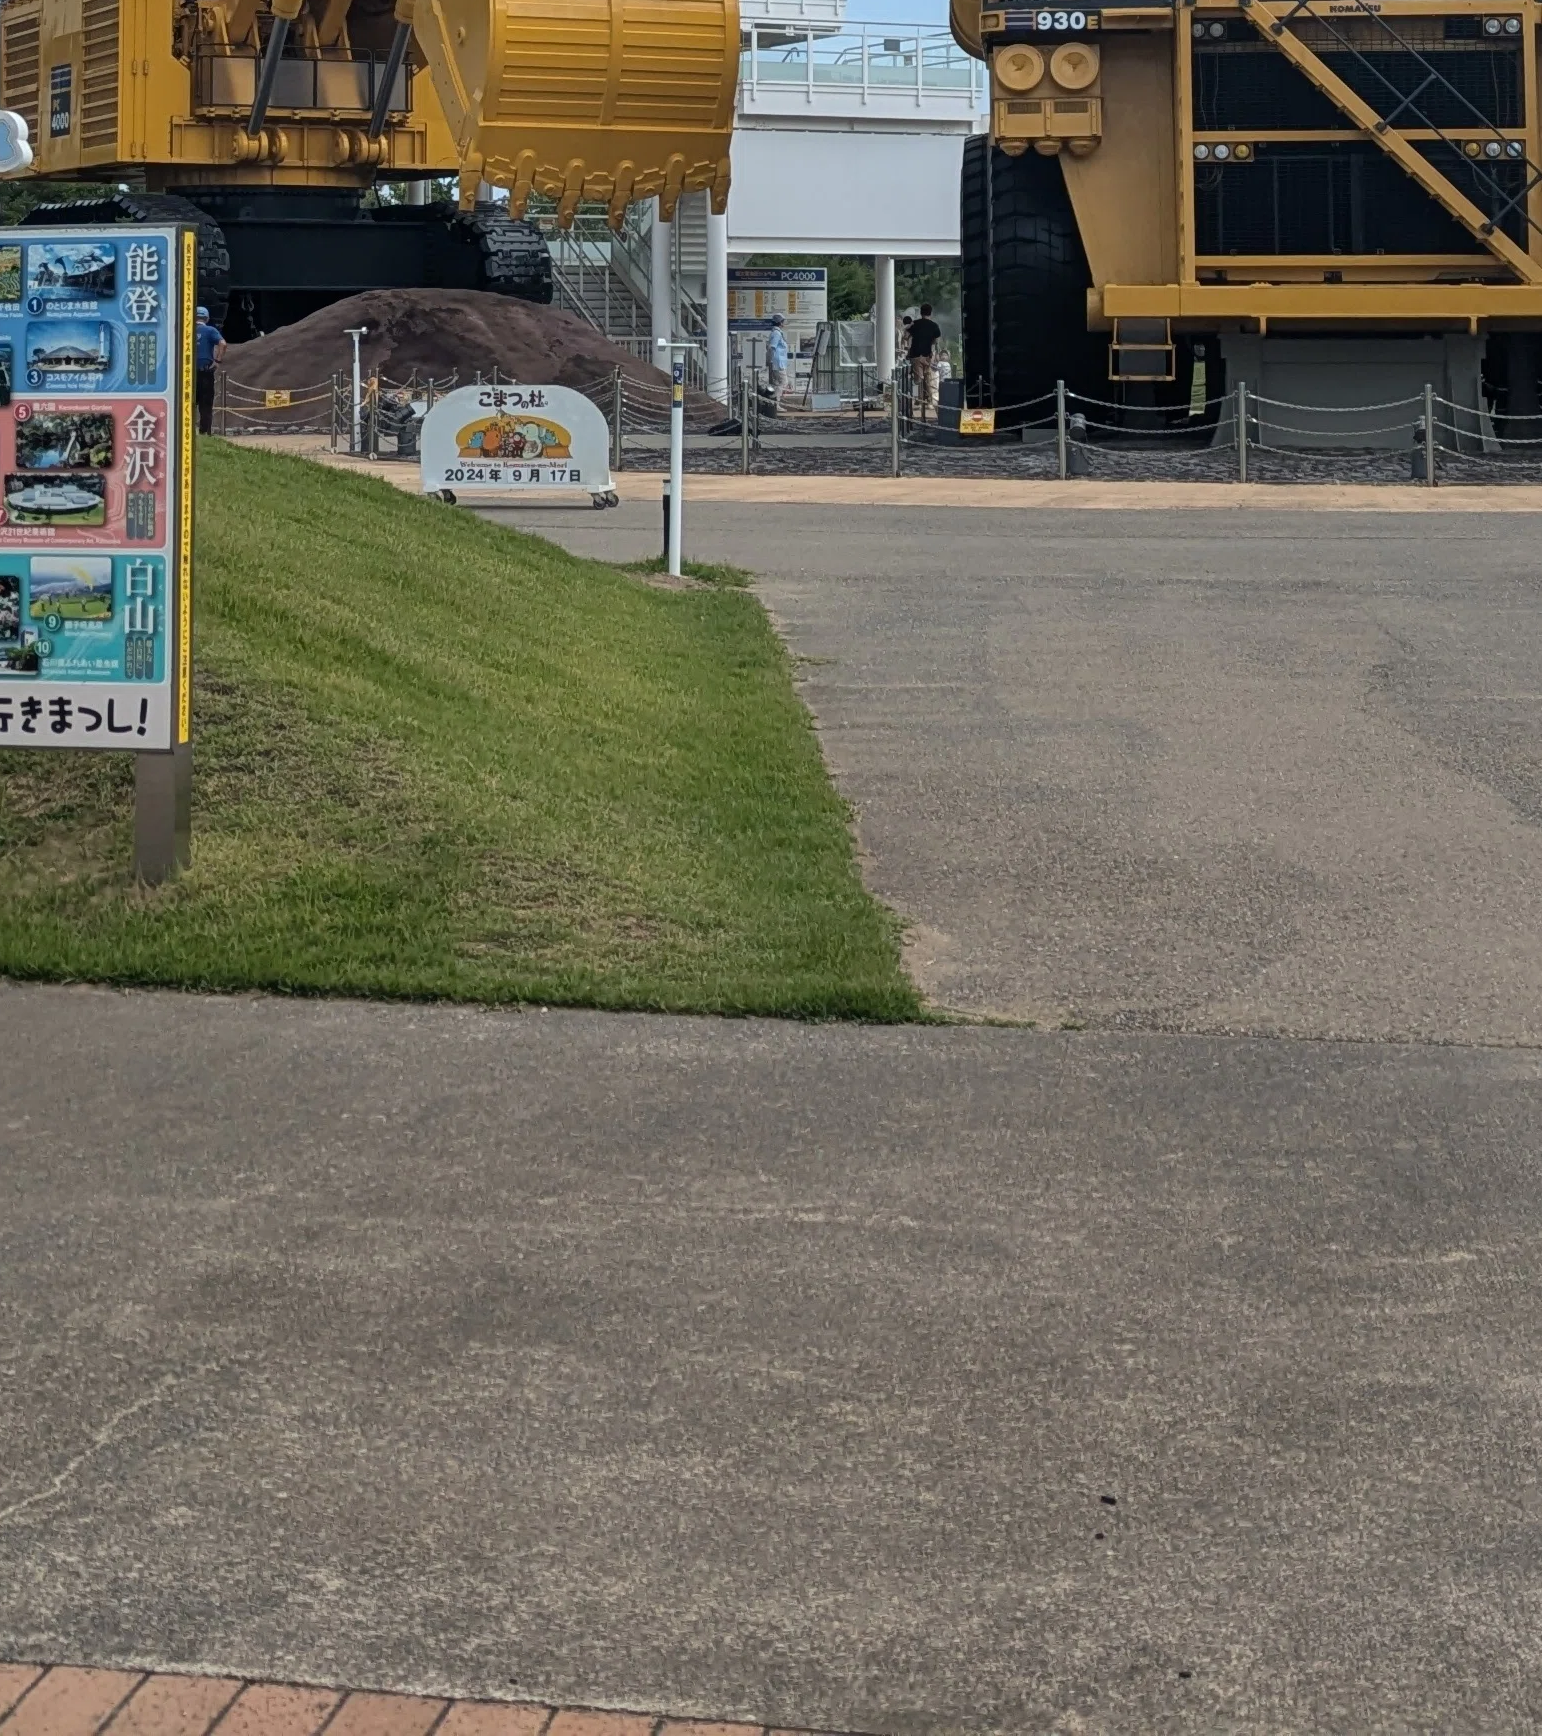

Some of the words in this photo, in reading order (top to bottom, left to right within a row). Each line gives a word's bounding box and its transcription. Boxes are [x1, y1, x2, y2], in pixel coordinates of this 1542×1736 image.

[1037, 11, 1099, 30] 930E
[52, 112, 69, 130] 4000
[124, 242, 159, 324] 能登
[780, 271, 816, 281] PC4000
[30, 371, 39, 383] 3
[478, 390, 545, 409] こまつの杜
[18, 406, 27, 419] 5
[123, 404, 158, 487] 金沢
[124, 558, 154, 635] 白山
[48, 615, 57, 628] 9
[37, 641, 49, 654] 10
